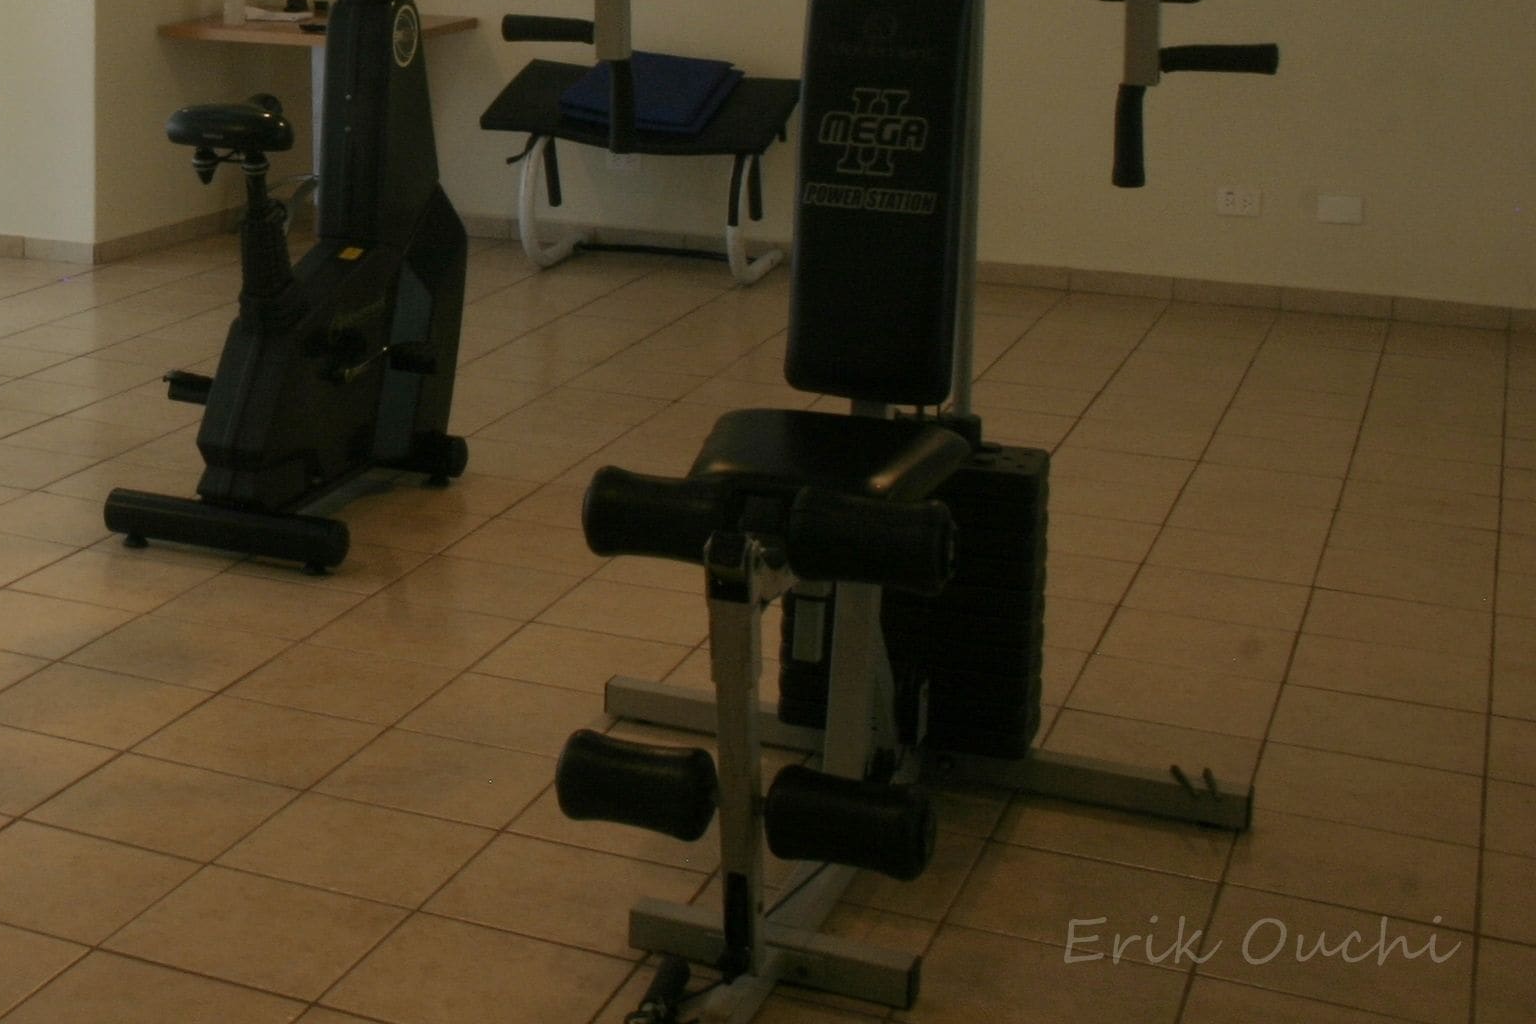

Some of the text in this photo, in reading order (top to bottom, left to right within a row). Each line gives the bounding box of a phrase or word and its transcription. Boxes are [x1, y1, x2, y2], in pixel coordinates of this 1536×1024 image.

[819, 111, 930, 152] MEGA
[802, 182, 938, 215] POWER STATION
